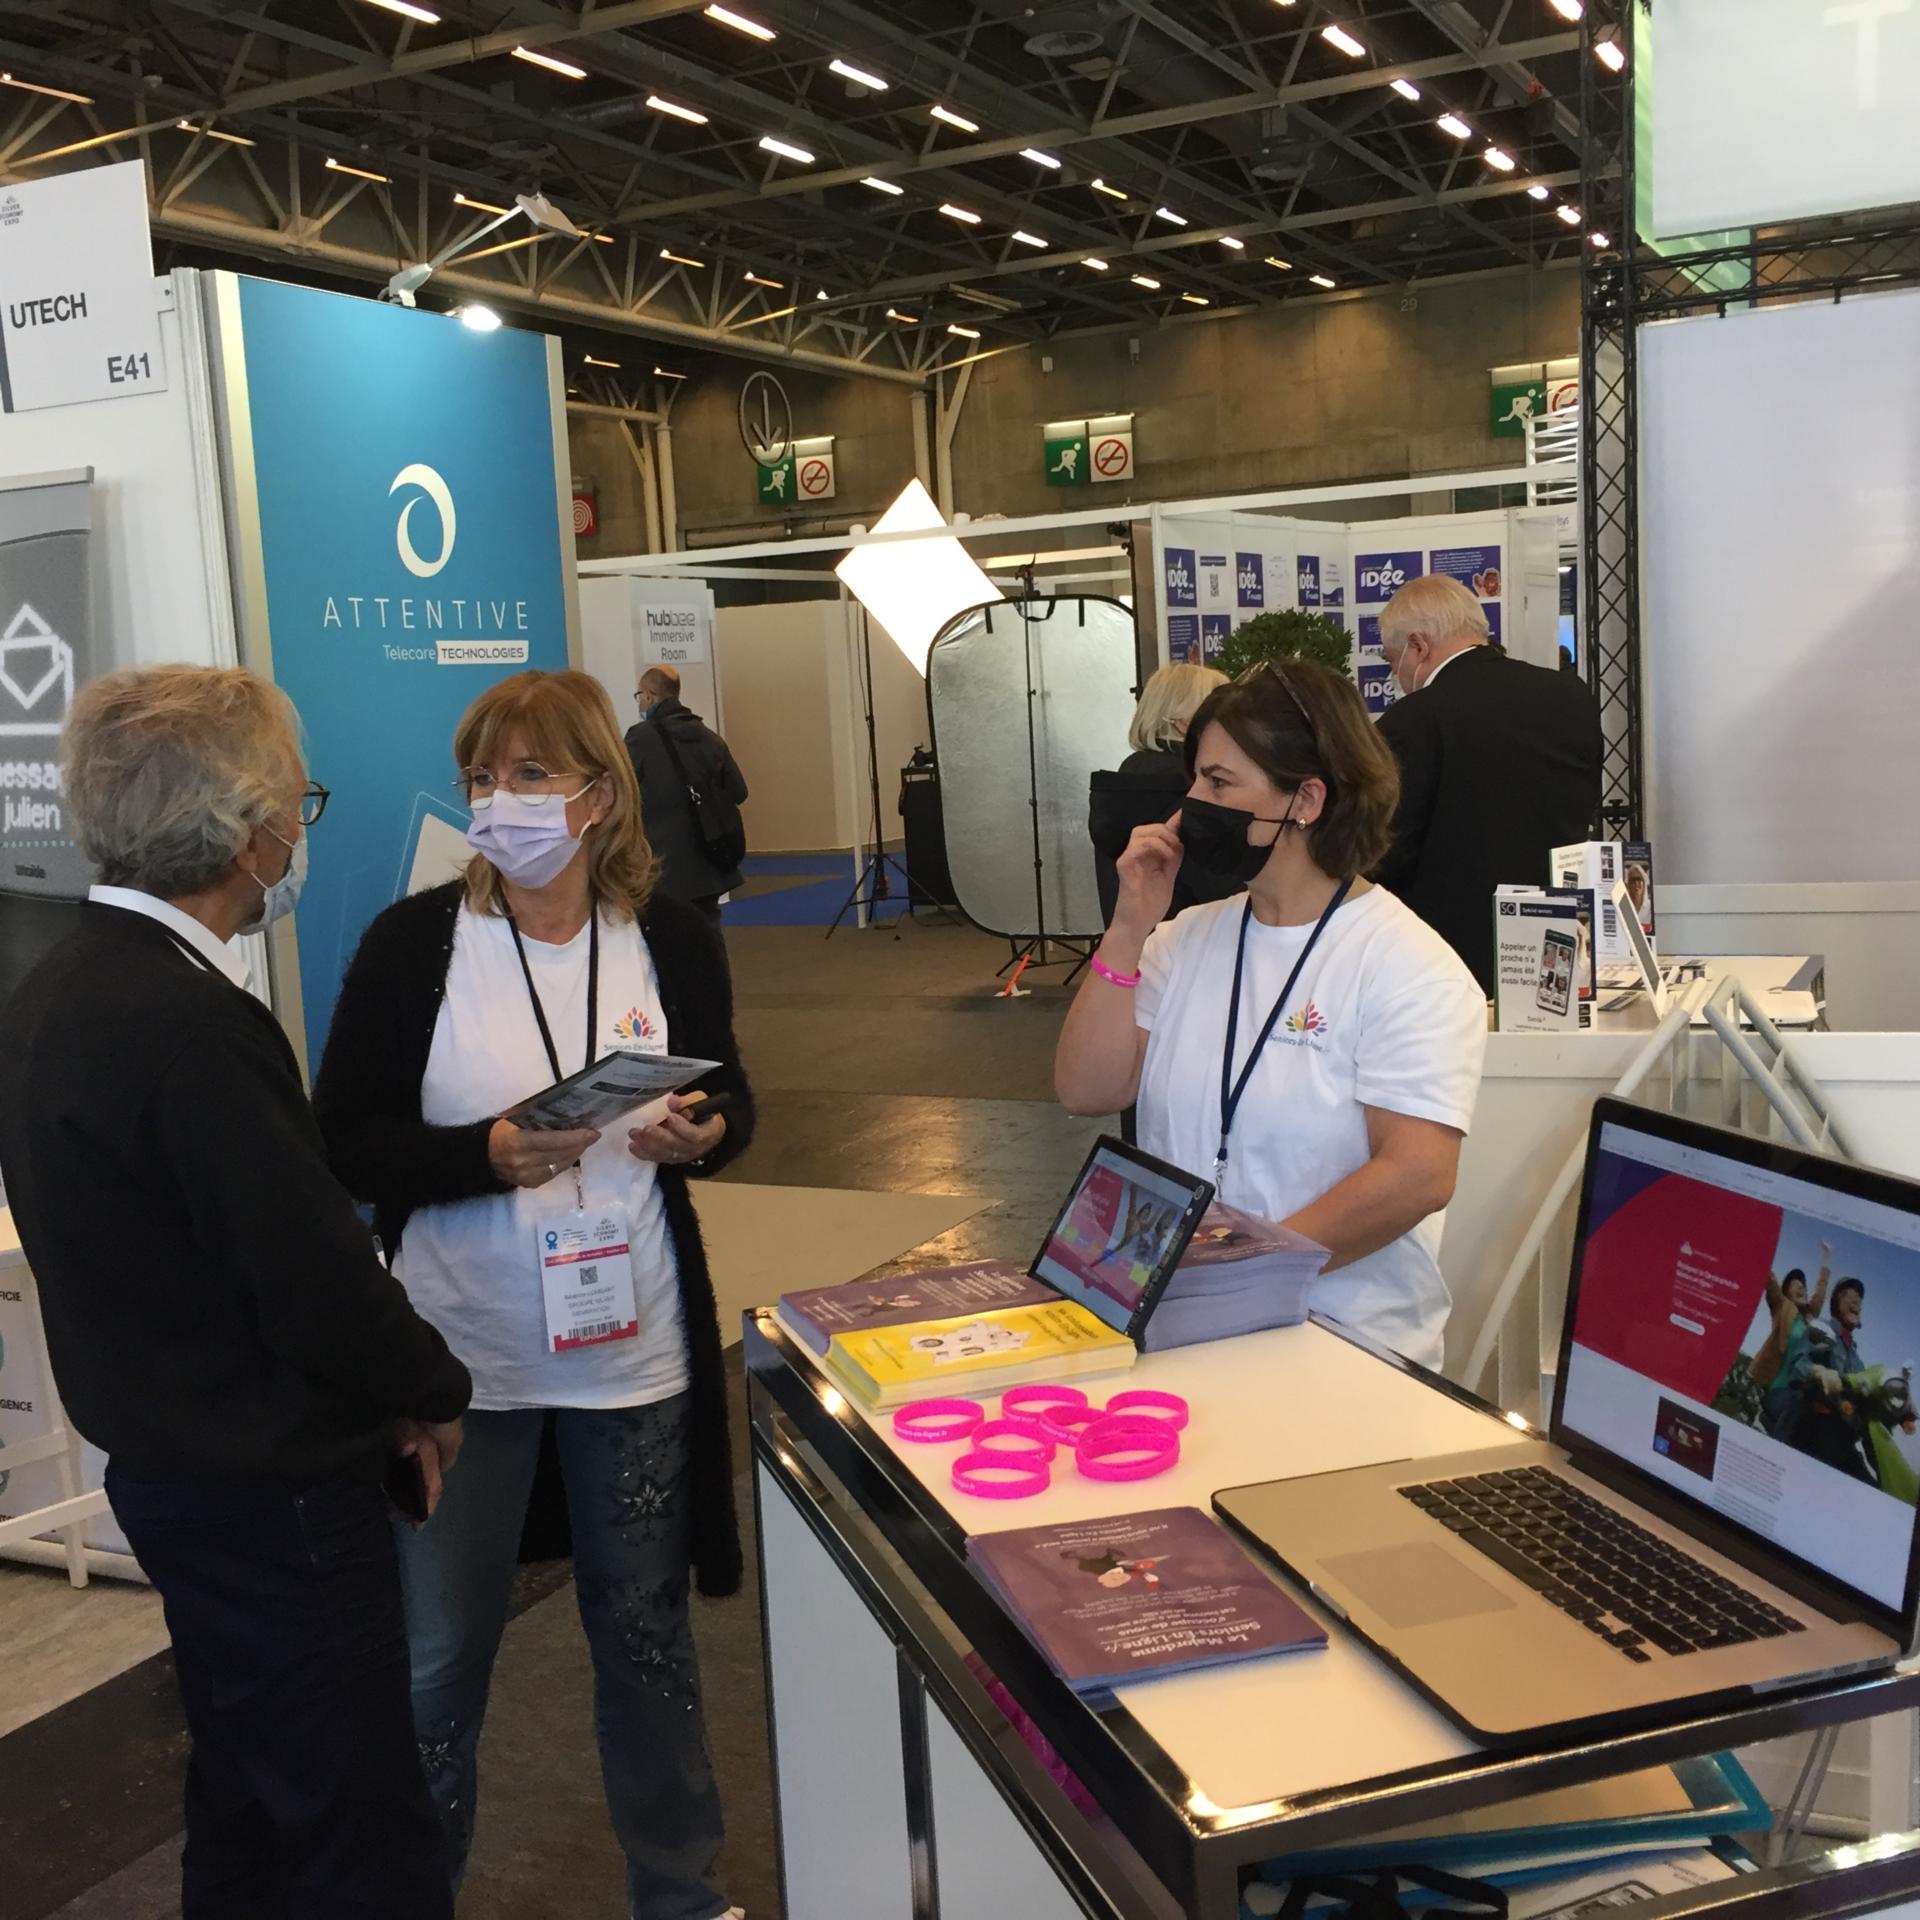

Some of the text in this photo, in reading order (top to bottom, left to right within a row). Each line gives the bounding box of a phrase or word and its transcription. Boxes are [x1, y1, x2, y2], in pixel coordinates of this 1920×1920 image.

[9, 292, 88, 329] UTECH
[107, 352, 151, 383] E41
[323, 597, 529, 630] ATTENTIVE
[649, 630, 695, 643] Immersive
[382, 644, 524, 661] Telecare TECHNOLOGIES
[661, 647, 687, 660] Room
[3, 795, 61, 833] julien
[1500, 942, 1526, 953] Appeler
[1500, 954, 1523, 964] proche
[1500, 965, 1523, 975] jamais
[1131, 1637, 1224, 1658] Majordome
